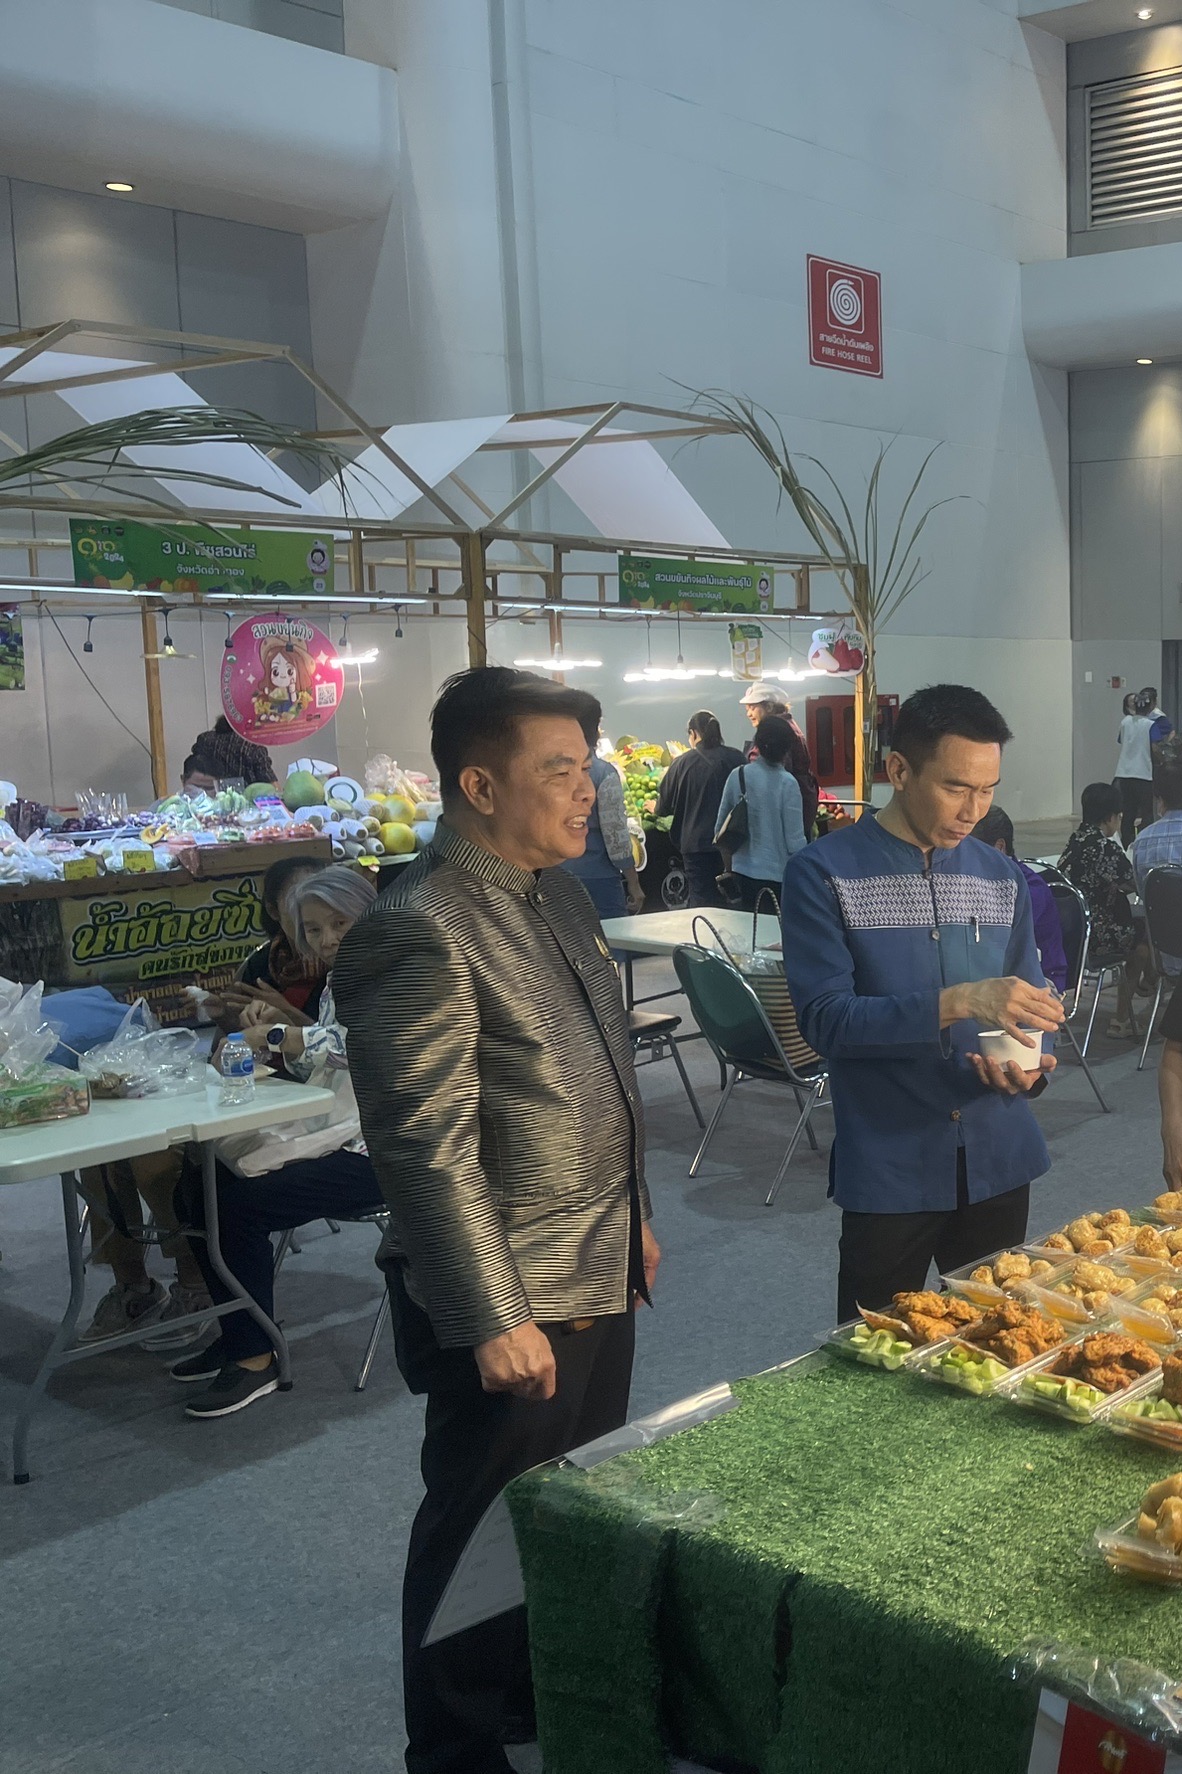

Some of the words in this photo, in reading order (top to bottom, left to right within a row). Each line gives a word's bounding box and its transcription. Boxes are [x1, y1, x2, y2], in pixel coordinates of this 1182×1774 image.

[822, 346, 836, 357] FIRE
[837, 350, 855, 361] HOSE
[856, 354, 872, 365] REEL
[161, 541, 172, 555] 3
